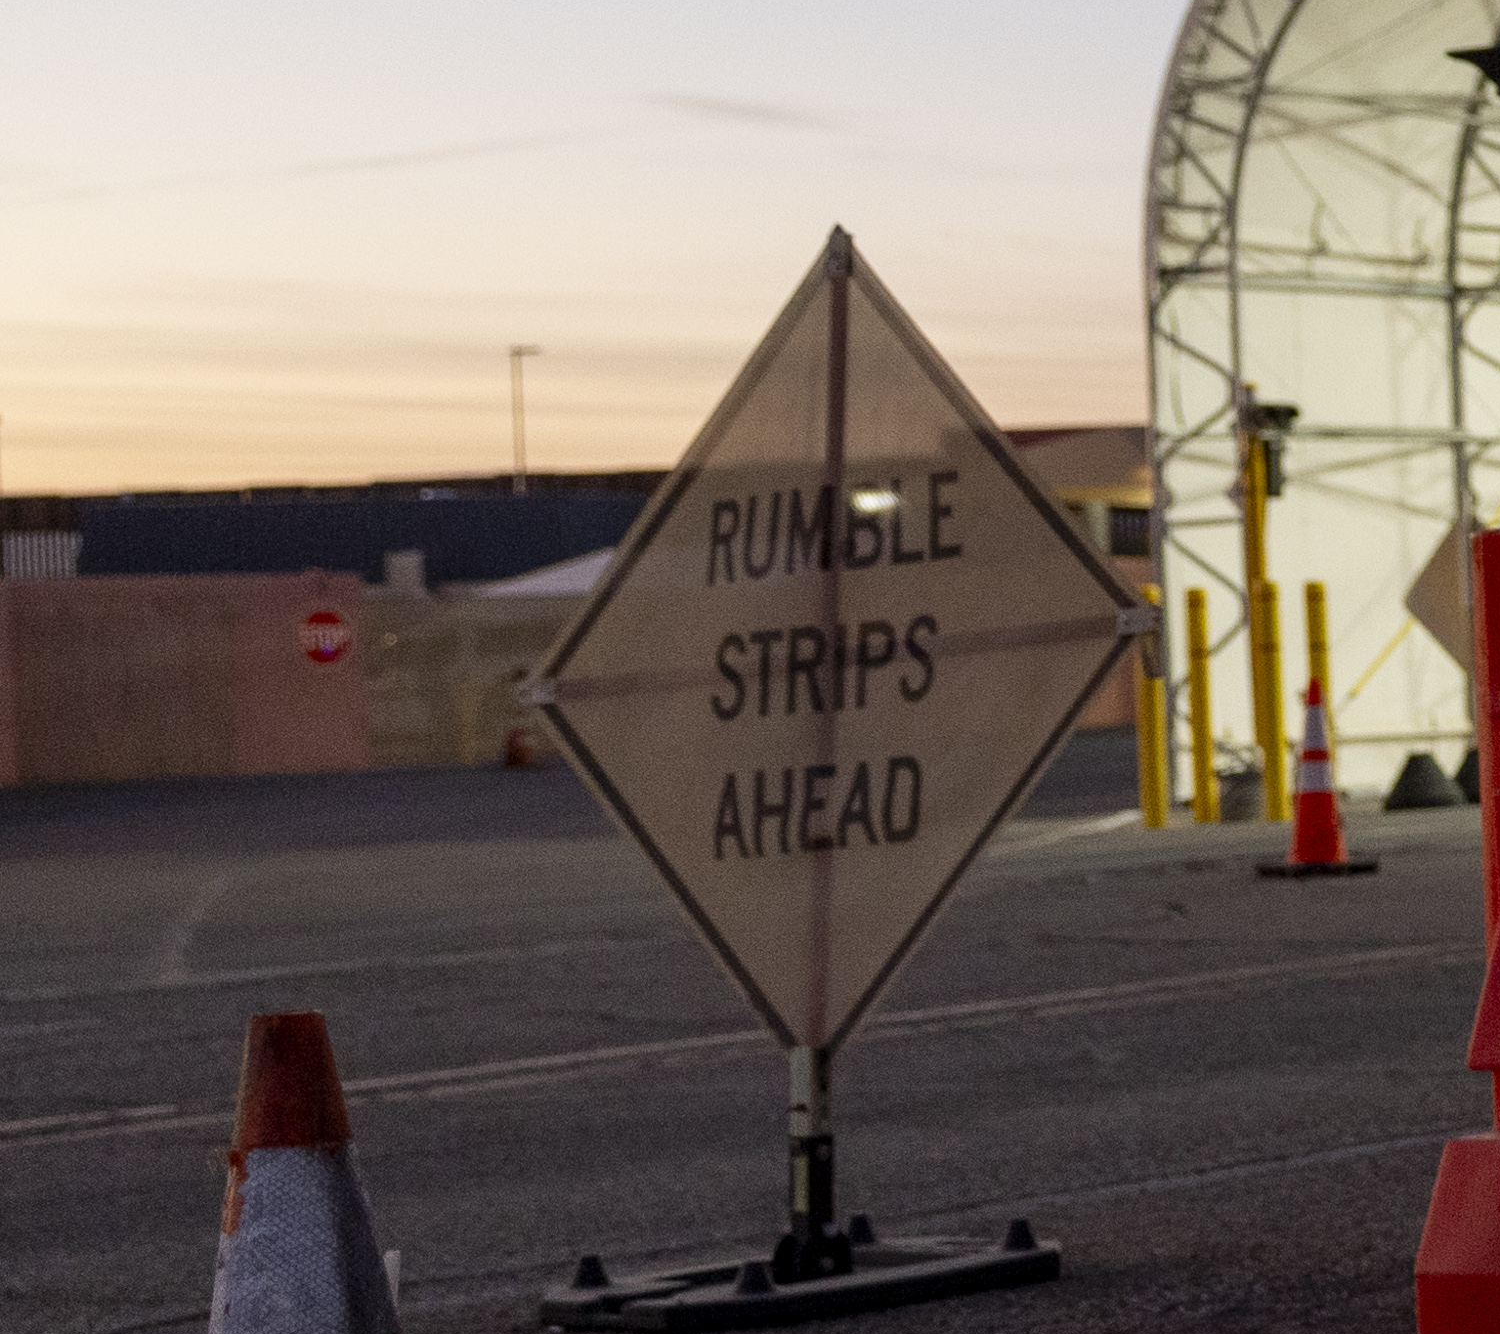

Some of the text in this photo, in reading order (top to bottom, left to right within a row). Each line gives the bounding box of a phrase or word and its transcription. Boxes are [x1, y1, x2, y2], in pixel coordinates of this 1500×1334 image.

[706, 470, 964, 586] RUMBLE
[711, 615, 938, 722] STRIPS
[713, 755, 923, 860] AHEAD
